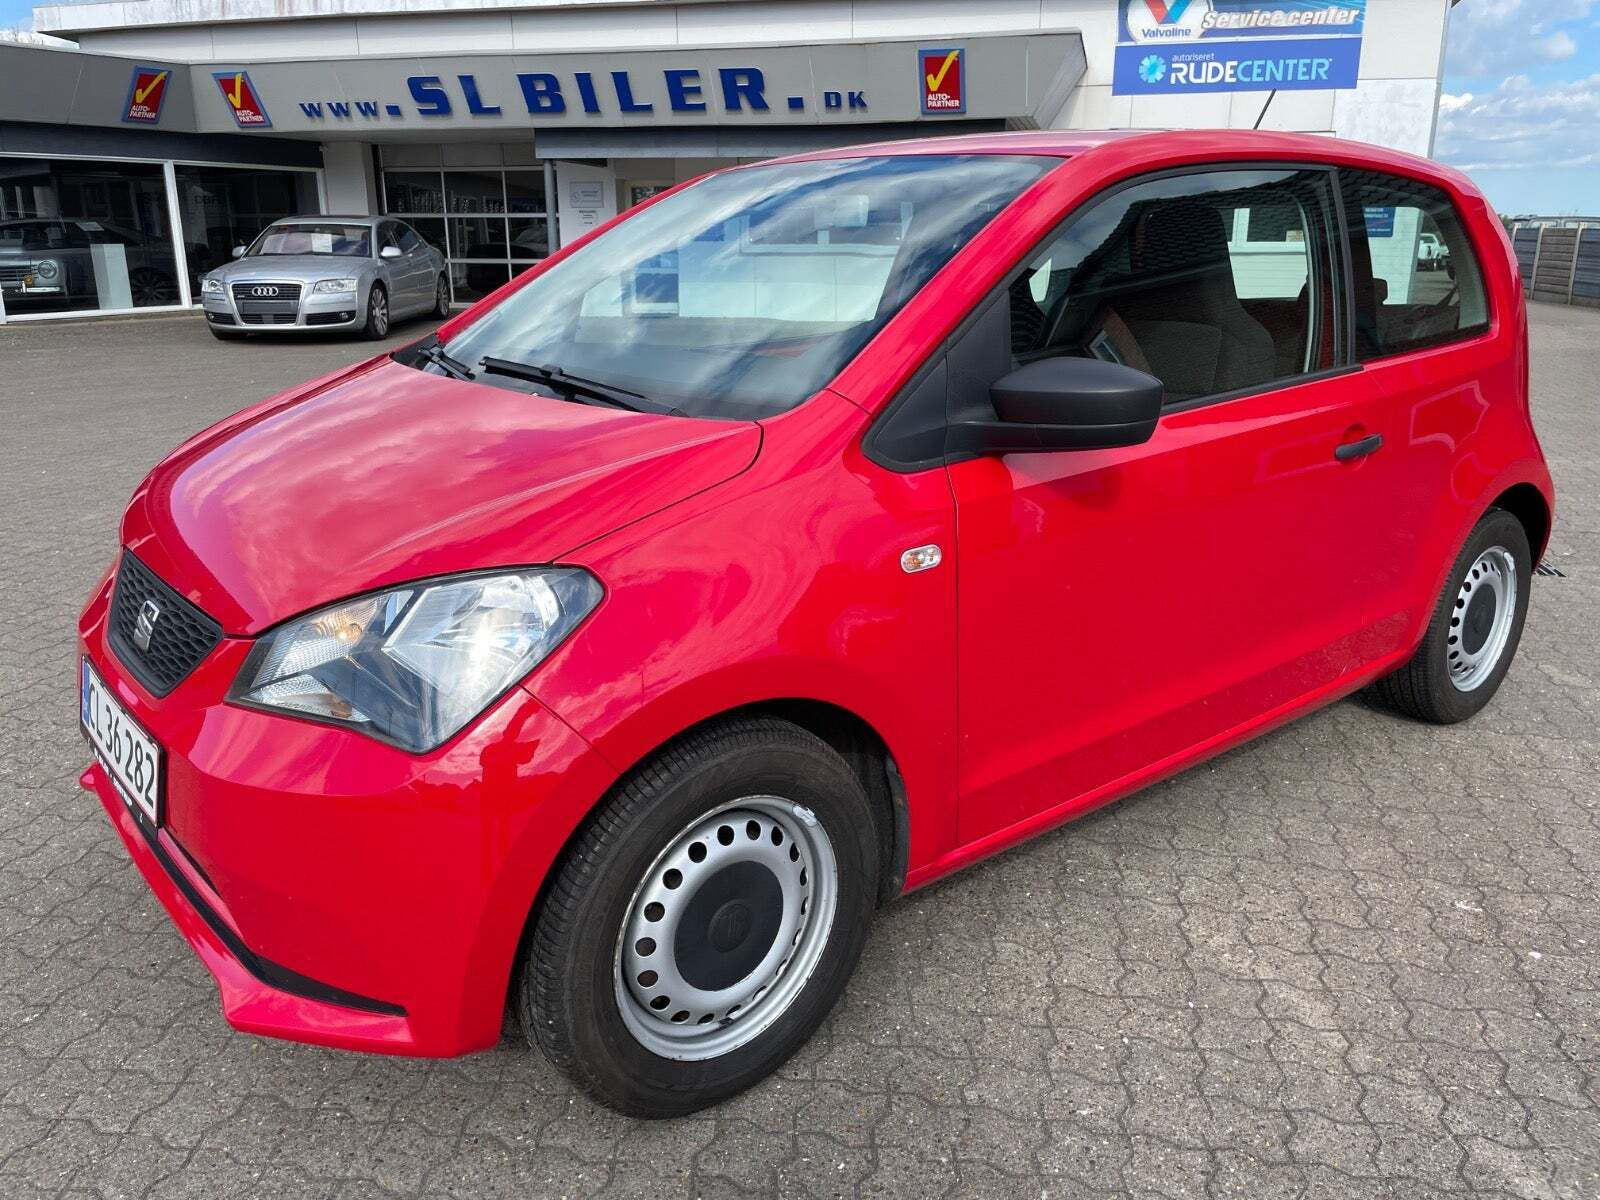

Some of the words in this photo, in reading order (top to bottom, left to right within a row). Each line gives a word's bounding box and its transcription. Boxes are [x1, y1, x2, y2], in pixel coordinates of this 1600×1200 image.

[1202, 10, 1288, 29] Service
[1287, 6, 1360, 25] center
[1142, 27, 1192, 38] Valvoline
[1172, 53, 1215, 62] autoriseret
[1170, 58, 1330, 84] RUDECENTER
[927, 93, 950, 101] AUTO-
[927, 99, 960, 108] PARTNER
[129, 110, 156, 119] PARTNER
[239, 114, 264, 123] PARTNER
[89, 683, 103, 741] CL
[105, 704, 121, 765] 36
[125, 729, 154, 808] 282
